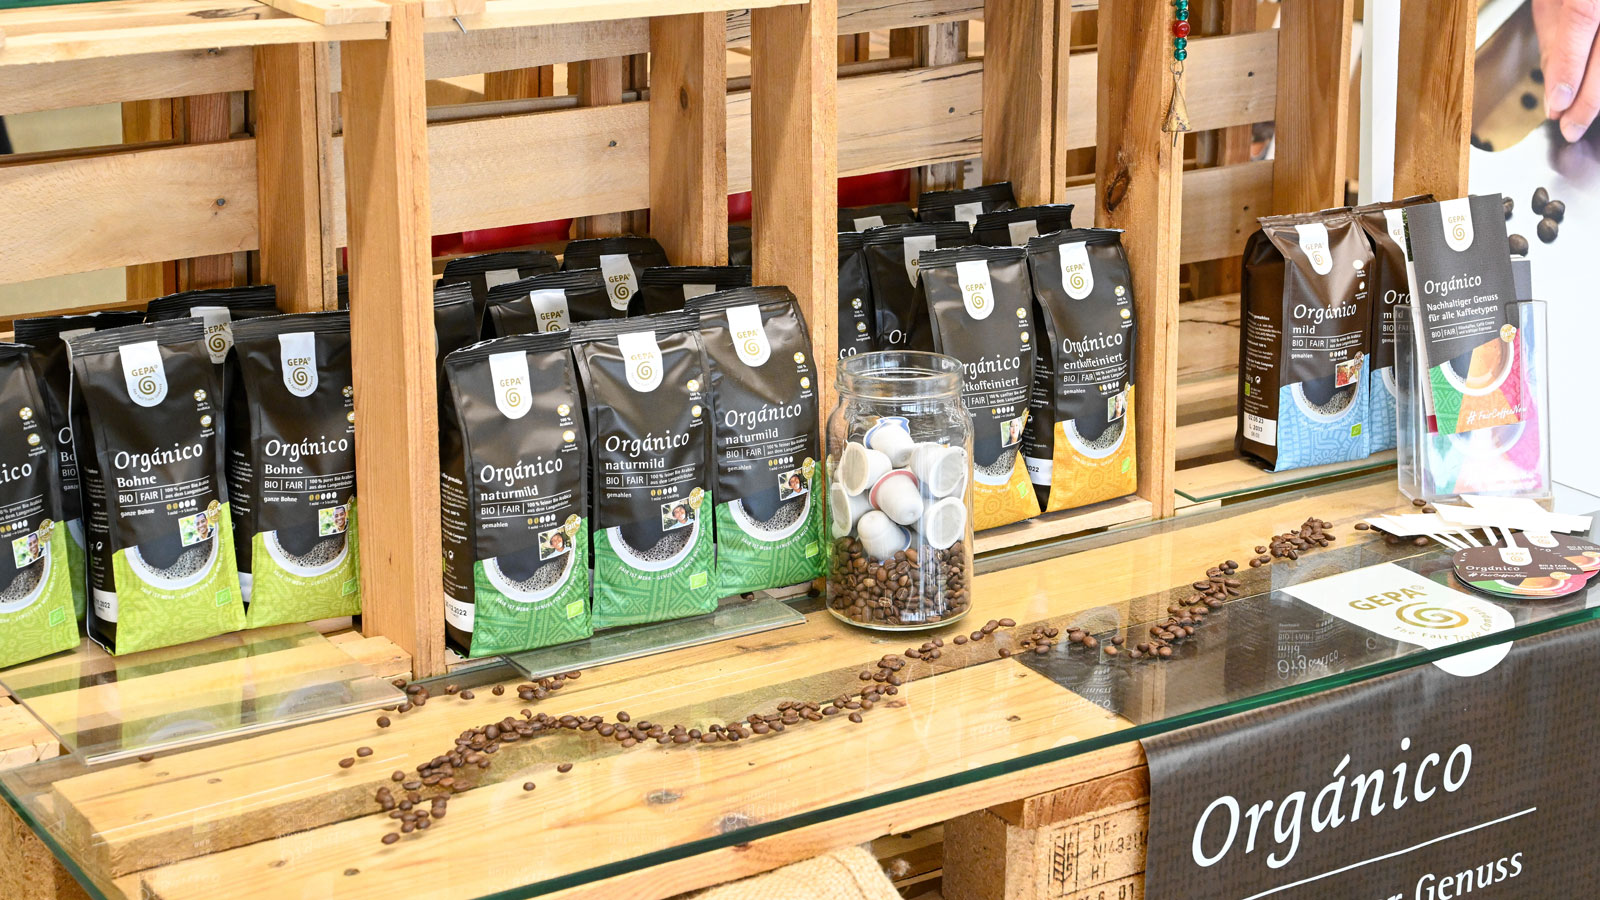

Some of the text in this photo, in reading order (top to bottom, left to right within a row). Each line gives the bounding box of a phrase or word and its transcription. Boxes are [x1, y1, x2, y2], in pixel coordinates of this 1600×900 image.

[1424, 273, 1482, 296] Orgánico
[1426, 293, 1499, 312] Nachhaltiger Genuss
[1294, 301, 1357, 324] Orgánico
[1428, 305, 1498, 323] für alle Kaffeetypen
[1292, 325, 1316, 334] mild
[1444, 328, 1456, 336] FAIR
[1063, 332, 1123, 357] Orgánico
[1292, 339, 1325, 348] BIO FAIR
[962, 354, 1020, 380] rgánico
[1064, 352, 1123, 369] entkoffeiniert
[1081, 373, 1094, 381] FAIR
[971, 397, 986, 405] FAIR
[725, 401, 802, 430] Orgánico
[605, 430, 690, 457] Orgánico
[725, 428, 779, 445] naturmild
[265, 436, 348, 462] Orgánico
[726, 448, 762, 459] BIO FAIR
[114, 443, 203, 473] Orgánico
[605, 457, 665, 470] naturmild
[265, 464, 304, 474] Bohne
[480, 456, 563, 487] Orgánico
[116, 475, 157, 488] Bohne
[264, 481, 303, 489] BIO FAIR
[606, 475, 644, 485] BIO FAIR
[119, 490, 159, 503] BIO FAIR
[480, 485, 539, 501] naturmild
[121, 508, 155, 518] ganze Bohne
[481, 505, 521, 515] BIO FAIR
[481, 521, 508, 530] gemahlen
[1192, 737, 1473, 869] Orgánico
[1416, 852, 1523, 900] Genuss
